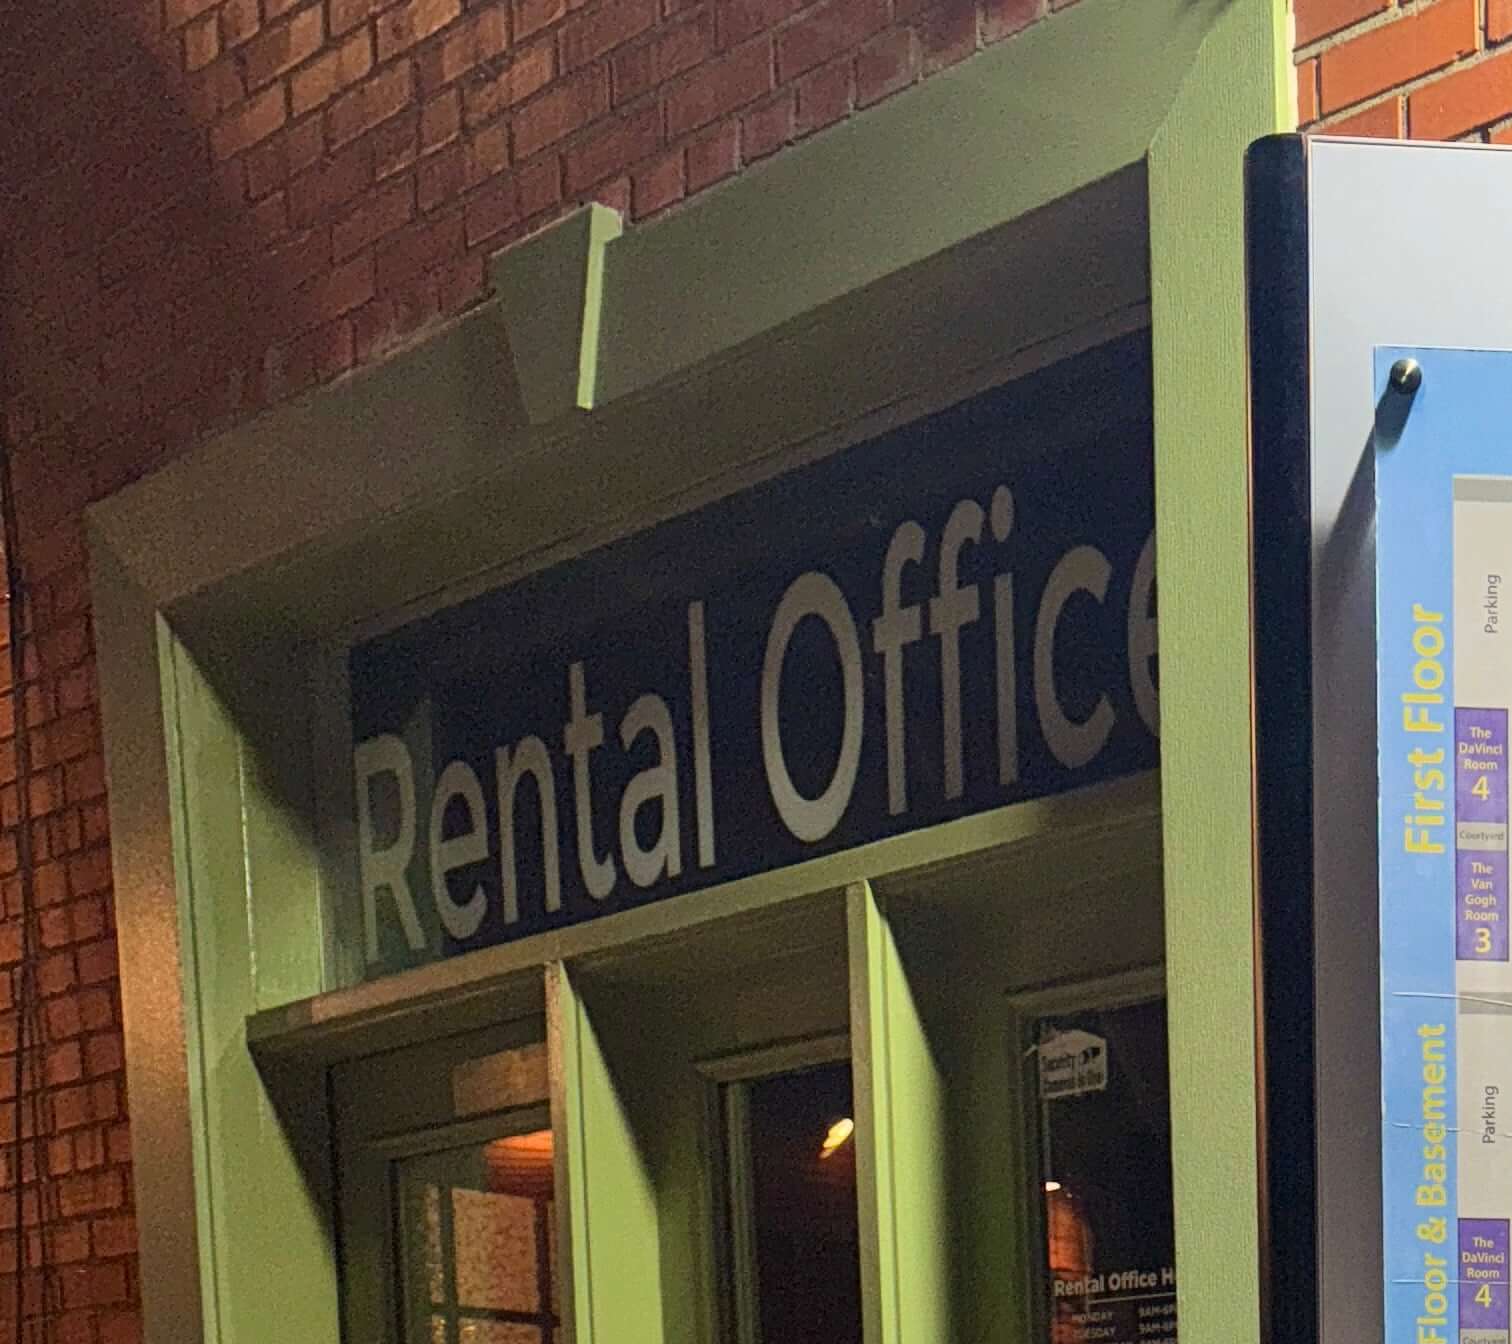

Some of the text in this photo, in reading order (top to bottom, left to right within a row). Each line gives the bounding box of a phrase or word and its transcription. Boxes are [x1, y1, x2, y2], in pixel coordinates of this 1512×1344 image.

[1484, 574, 1502, 633] Parking
[1401, 602, 1445, 854] First Floor
[1470, 727, 1491, 739] The
[1459, 743, 1503, 755] DaVinci
[1464, 759, 1498, 771] Room
[354, 601, 717, 966] Rental
[1471, 776, 1490, 800] 4
[1471, 862, 1493, 874] The
[1471, 878, 1493, 890] Van
[1465, 894, 1497, 907] Gogh
[1465, 910, 1499, 922] Room
[1475, 928, 1492, 953] 3
[1417, 1023, 1446, 1206] Basement
[1482, 1085, 1500, 1144] Parking
[1417, 1217, 1446, 1244] &
[1472, 1237, 1494, 1249] The
[1462, 1252, 1505, 1265] DaVinci
[1467, 1267, 1500, 1279] Room
[1054, 1275, 1104, 1296] Rental
[1108, 1269, 1157, 1292] Office
[1474, 1283, 1493, 1308] 4
